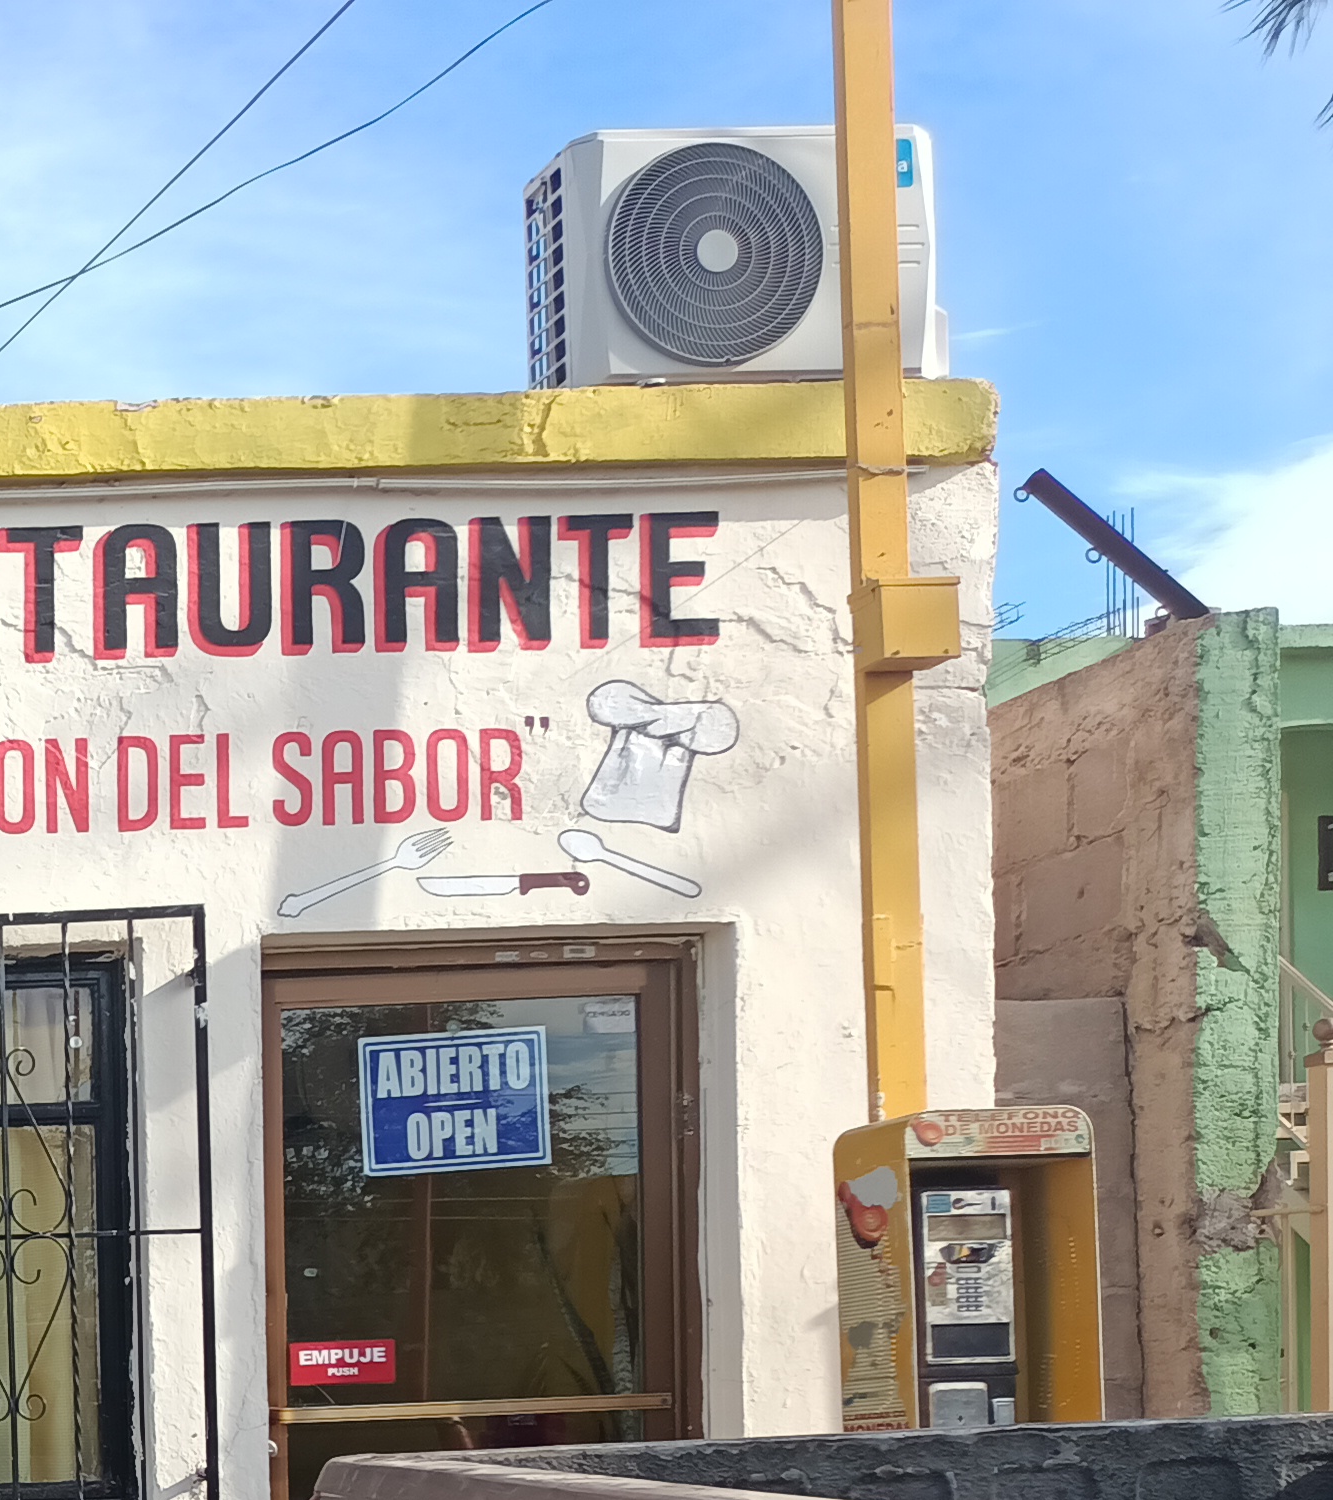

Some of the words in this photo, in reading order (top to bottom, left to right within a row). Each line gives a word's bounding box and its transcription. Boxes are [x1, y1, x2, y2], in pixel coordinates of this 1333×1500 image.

[117, 733, 250, 833] DEL
[376, 1041, 532, 1099] ABIERTO
[406, 1107, 499, 1161] OPEN
[944, 1124, 971, 1136] DE
[979, 1121, 1079, 1135] MONEDAS
[298, 1347, 386, 1366] EMPUJE
[327, 1366, 359, 1377] PUSH
